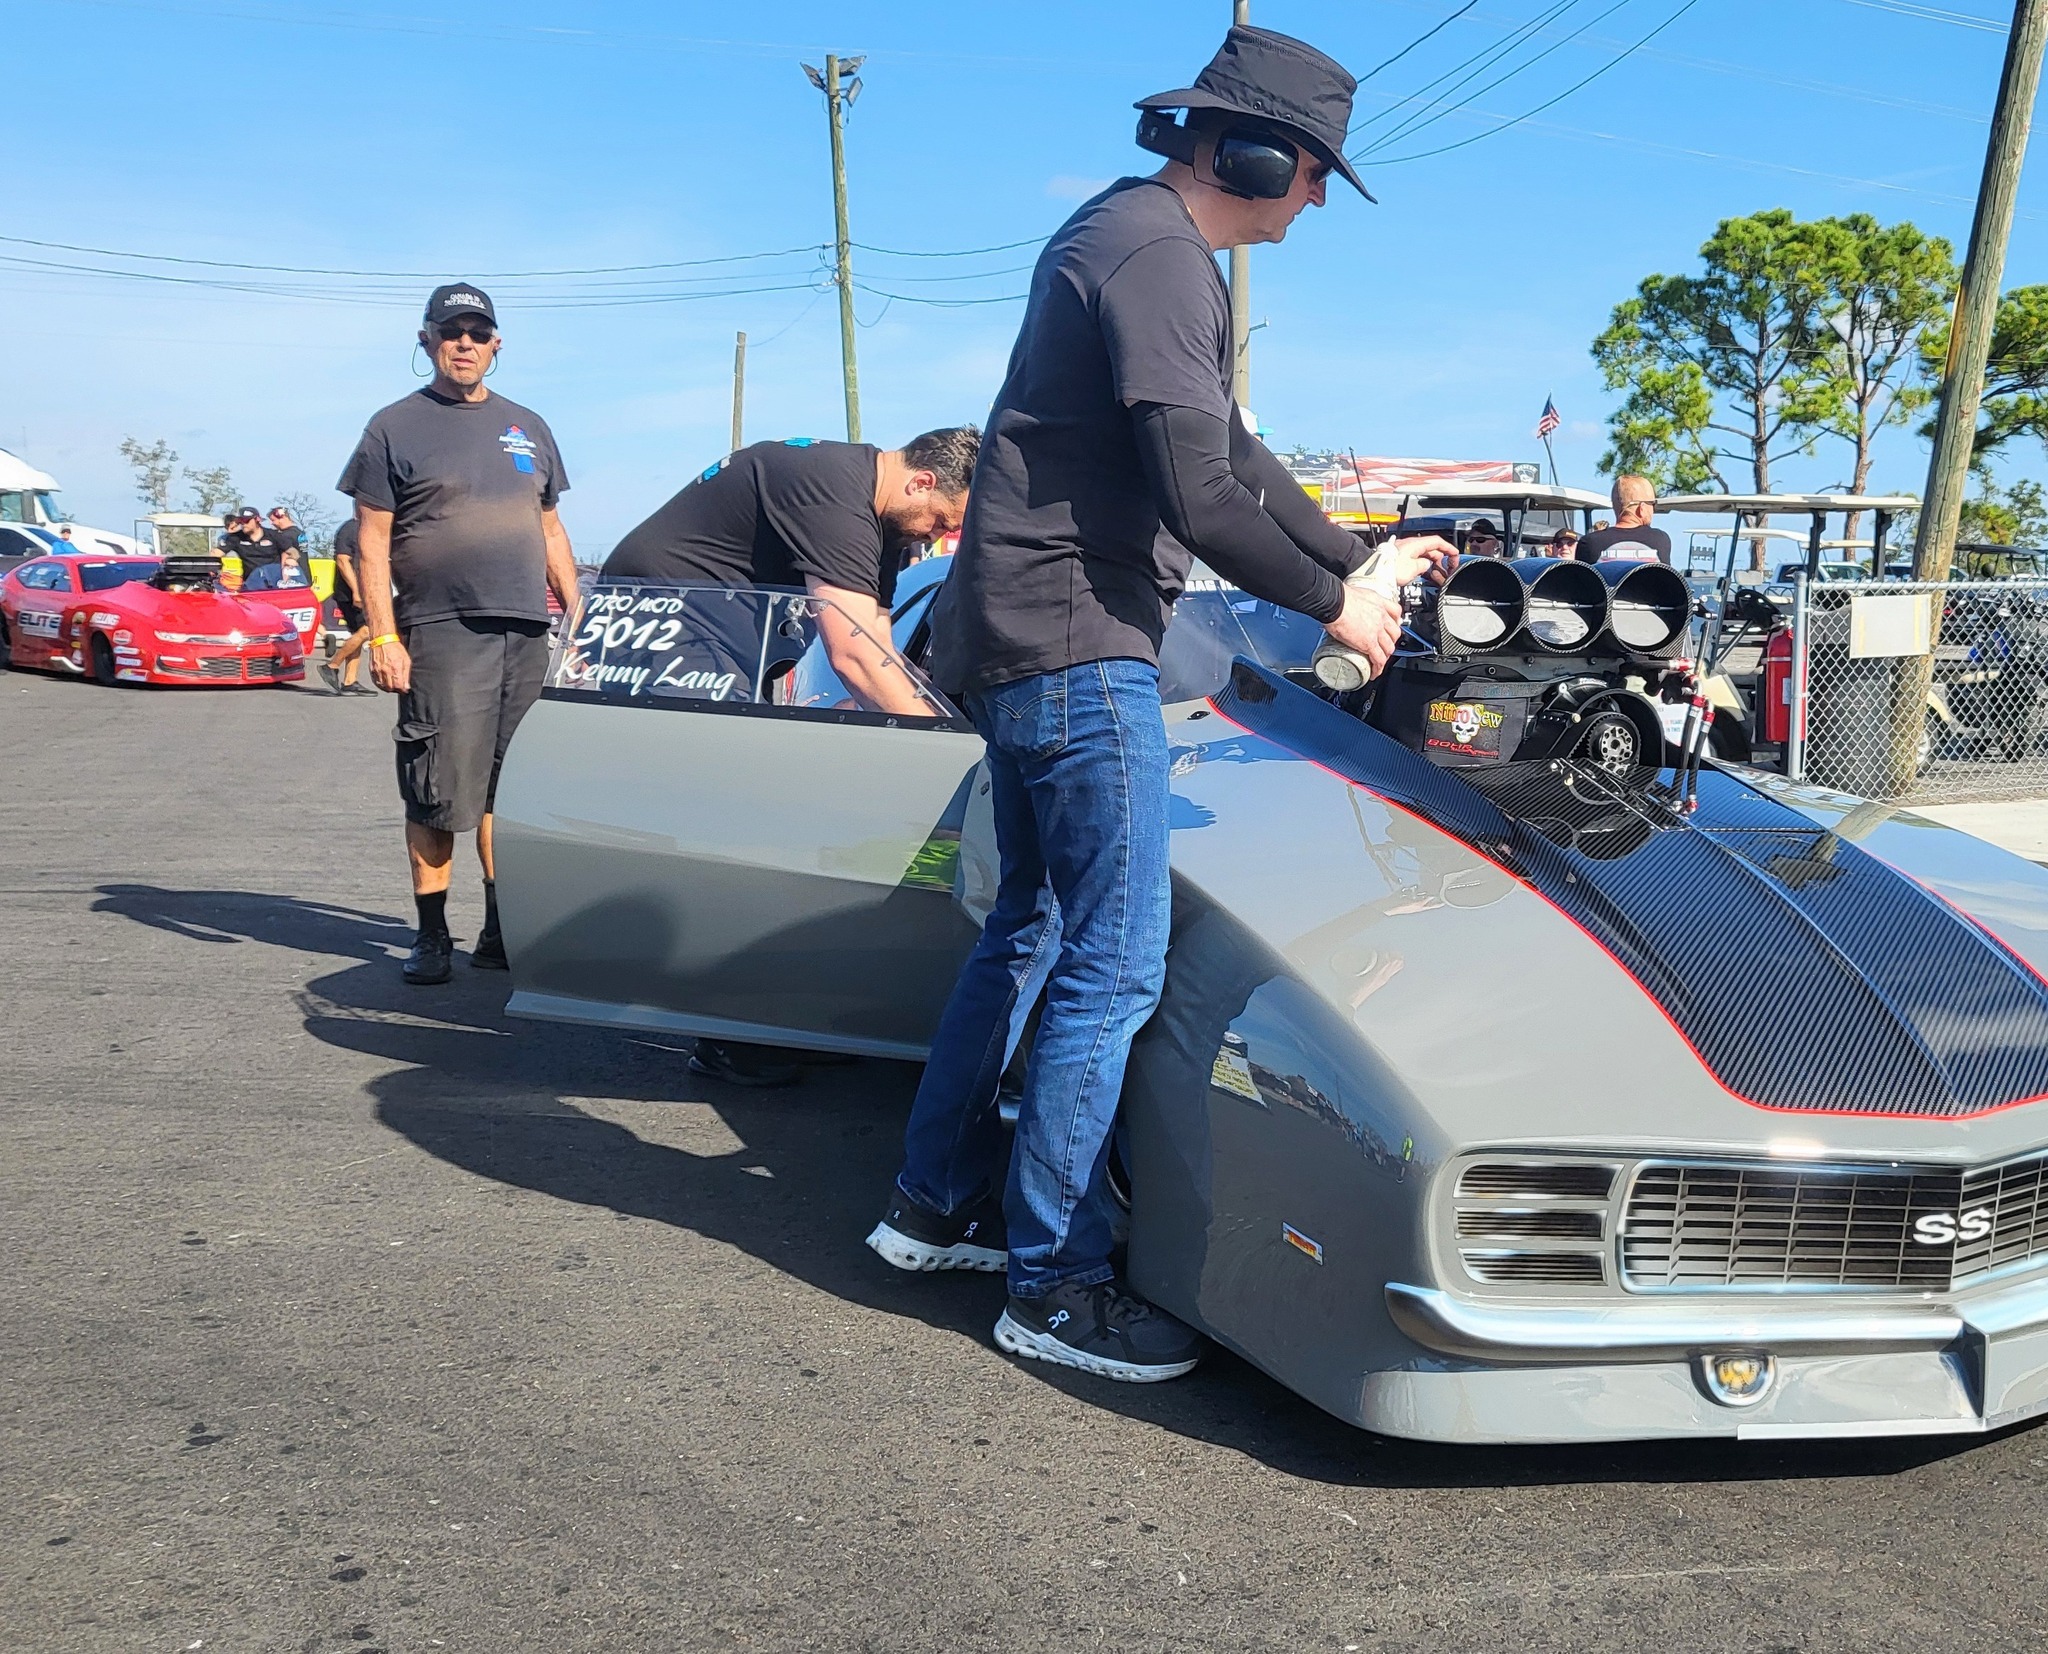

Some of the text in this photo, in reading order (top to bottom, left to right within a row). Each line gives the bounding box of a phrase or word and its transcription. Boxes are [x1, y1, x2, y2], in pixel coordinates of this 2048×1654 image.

[588, 594, 684, 614] PRO MOD
[20, 613, 60, 628] ELITE
[574, 615, 682, 650] 5012
[554, 651, 736, 701] Kenny Lang
[1429, 702, 1503, 728] Nitro Sew
[1913, 1207, 1991, 1244] SS
